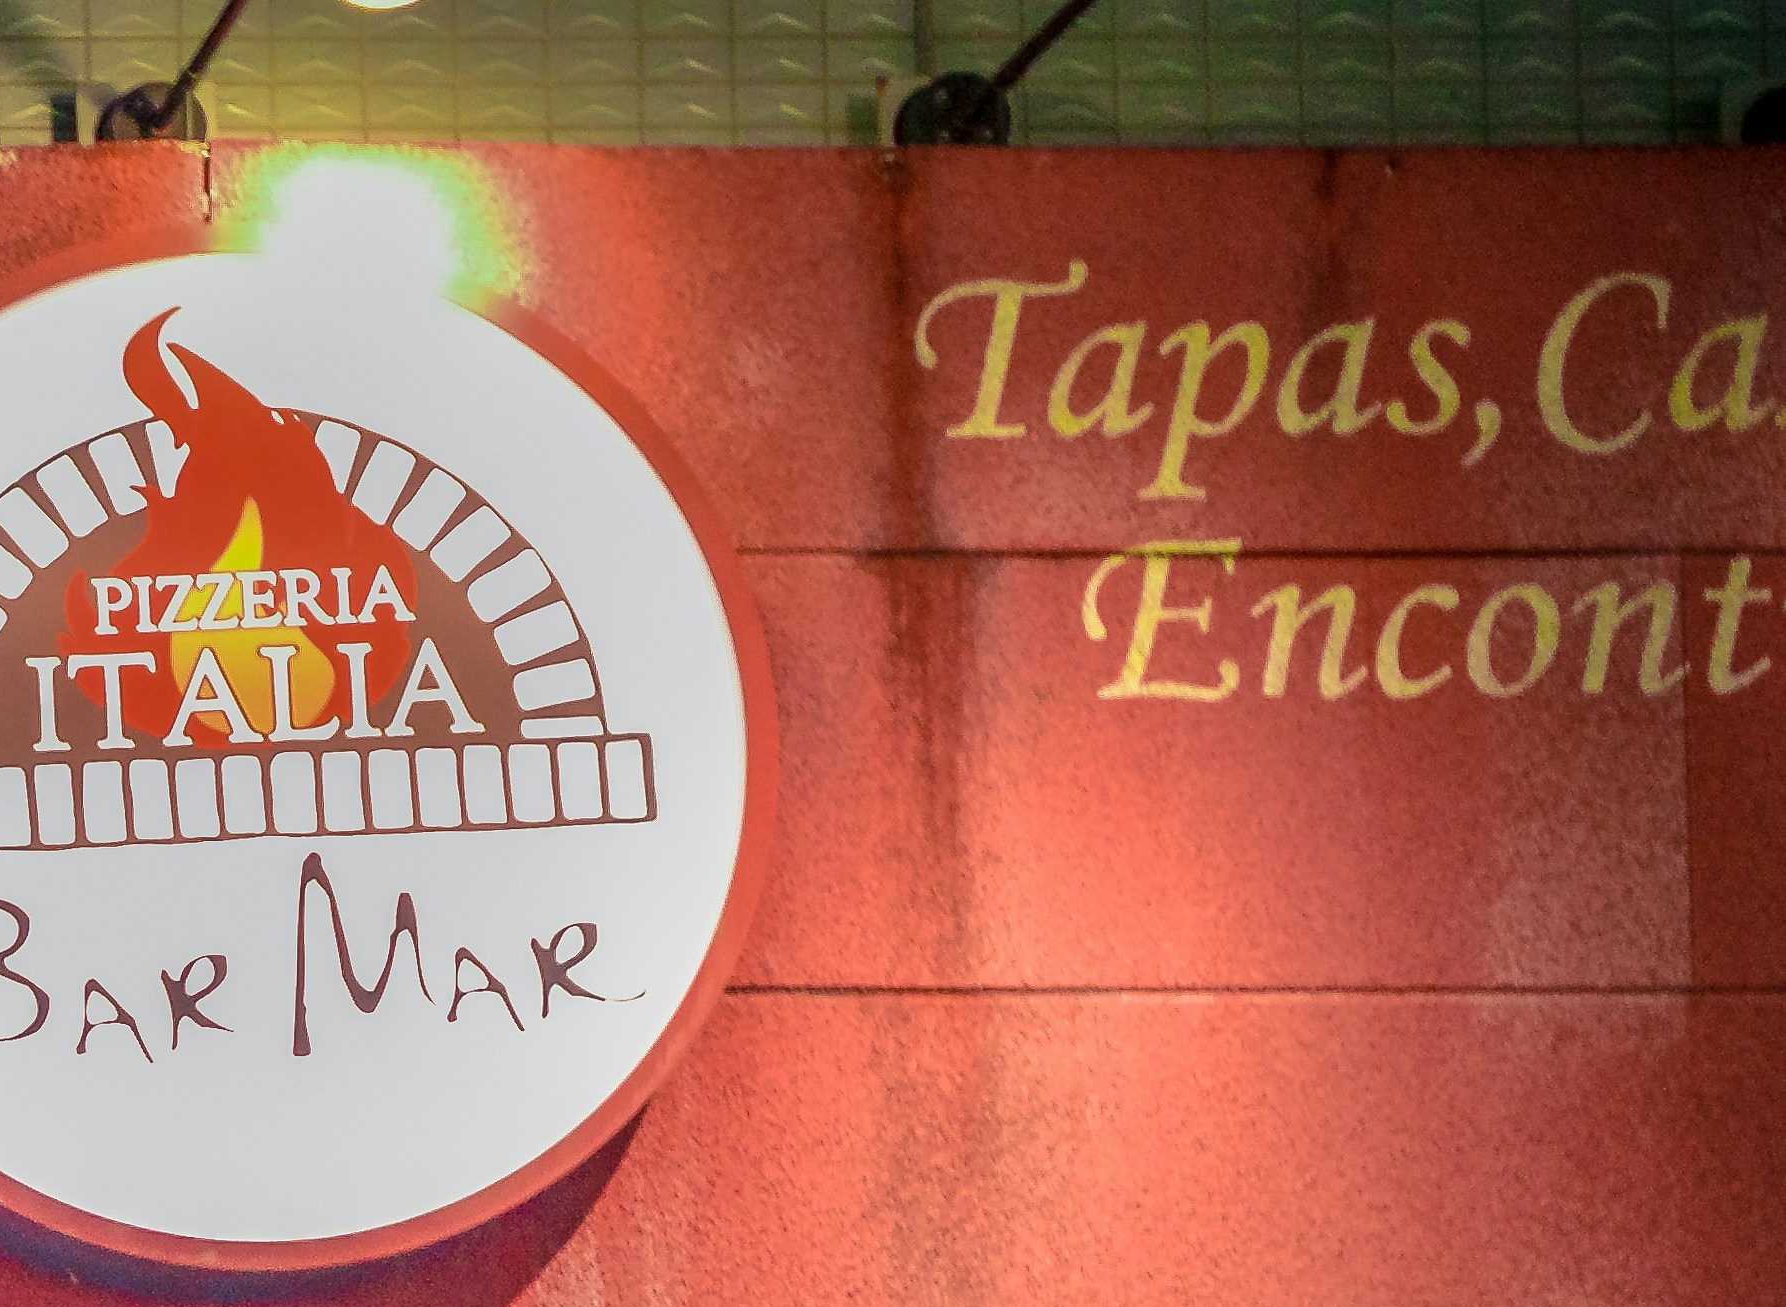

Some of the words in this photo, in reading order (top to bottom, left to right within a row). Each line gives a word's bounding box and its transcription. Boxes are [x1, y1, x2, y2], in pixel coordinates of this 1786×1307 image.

[89, 562, 416, 637] PIZZERIA
[1081, 538, 1786, 702] Encont
[25, 637, 485, 754] ITALIA
